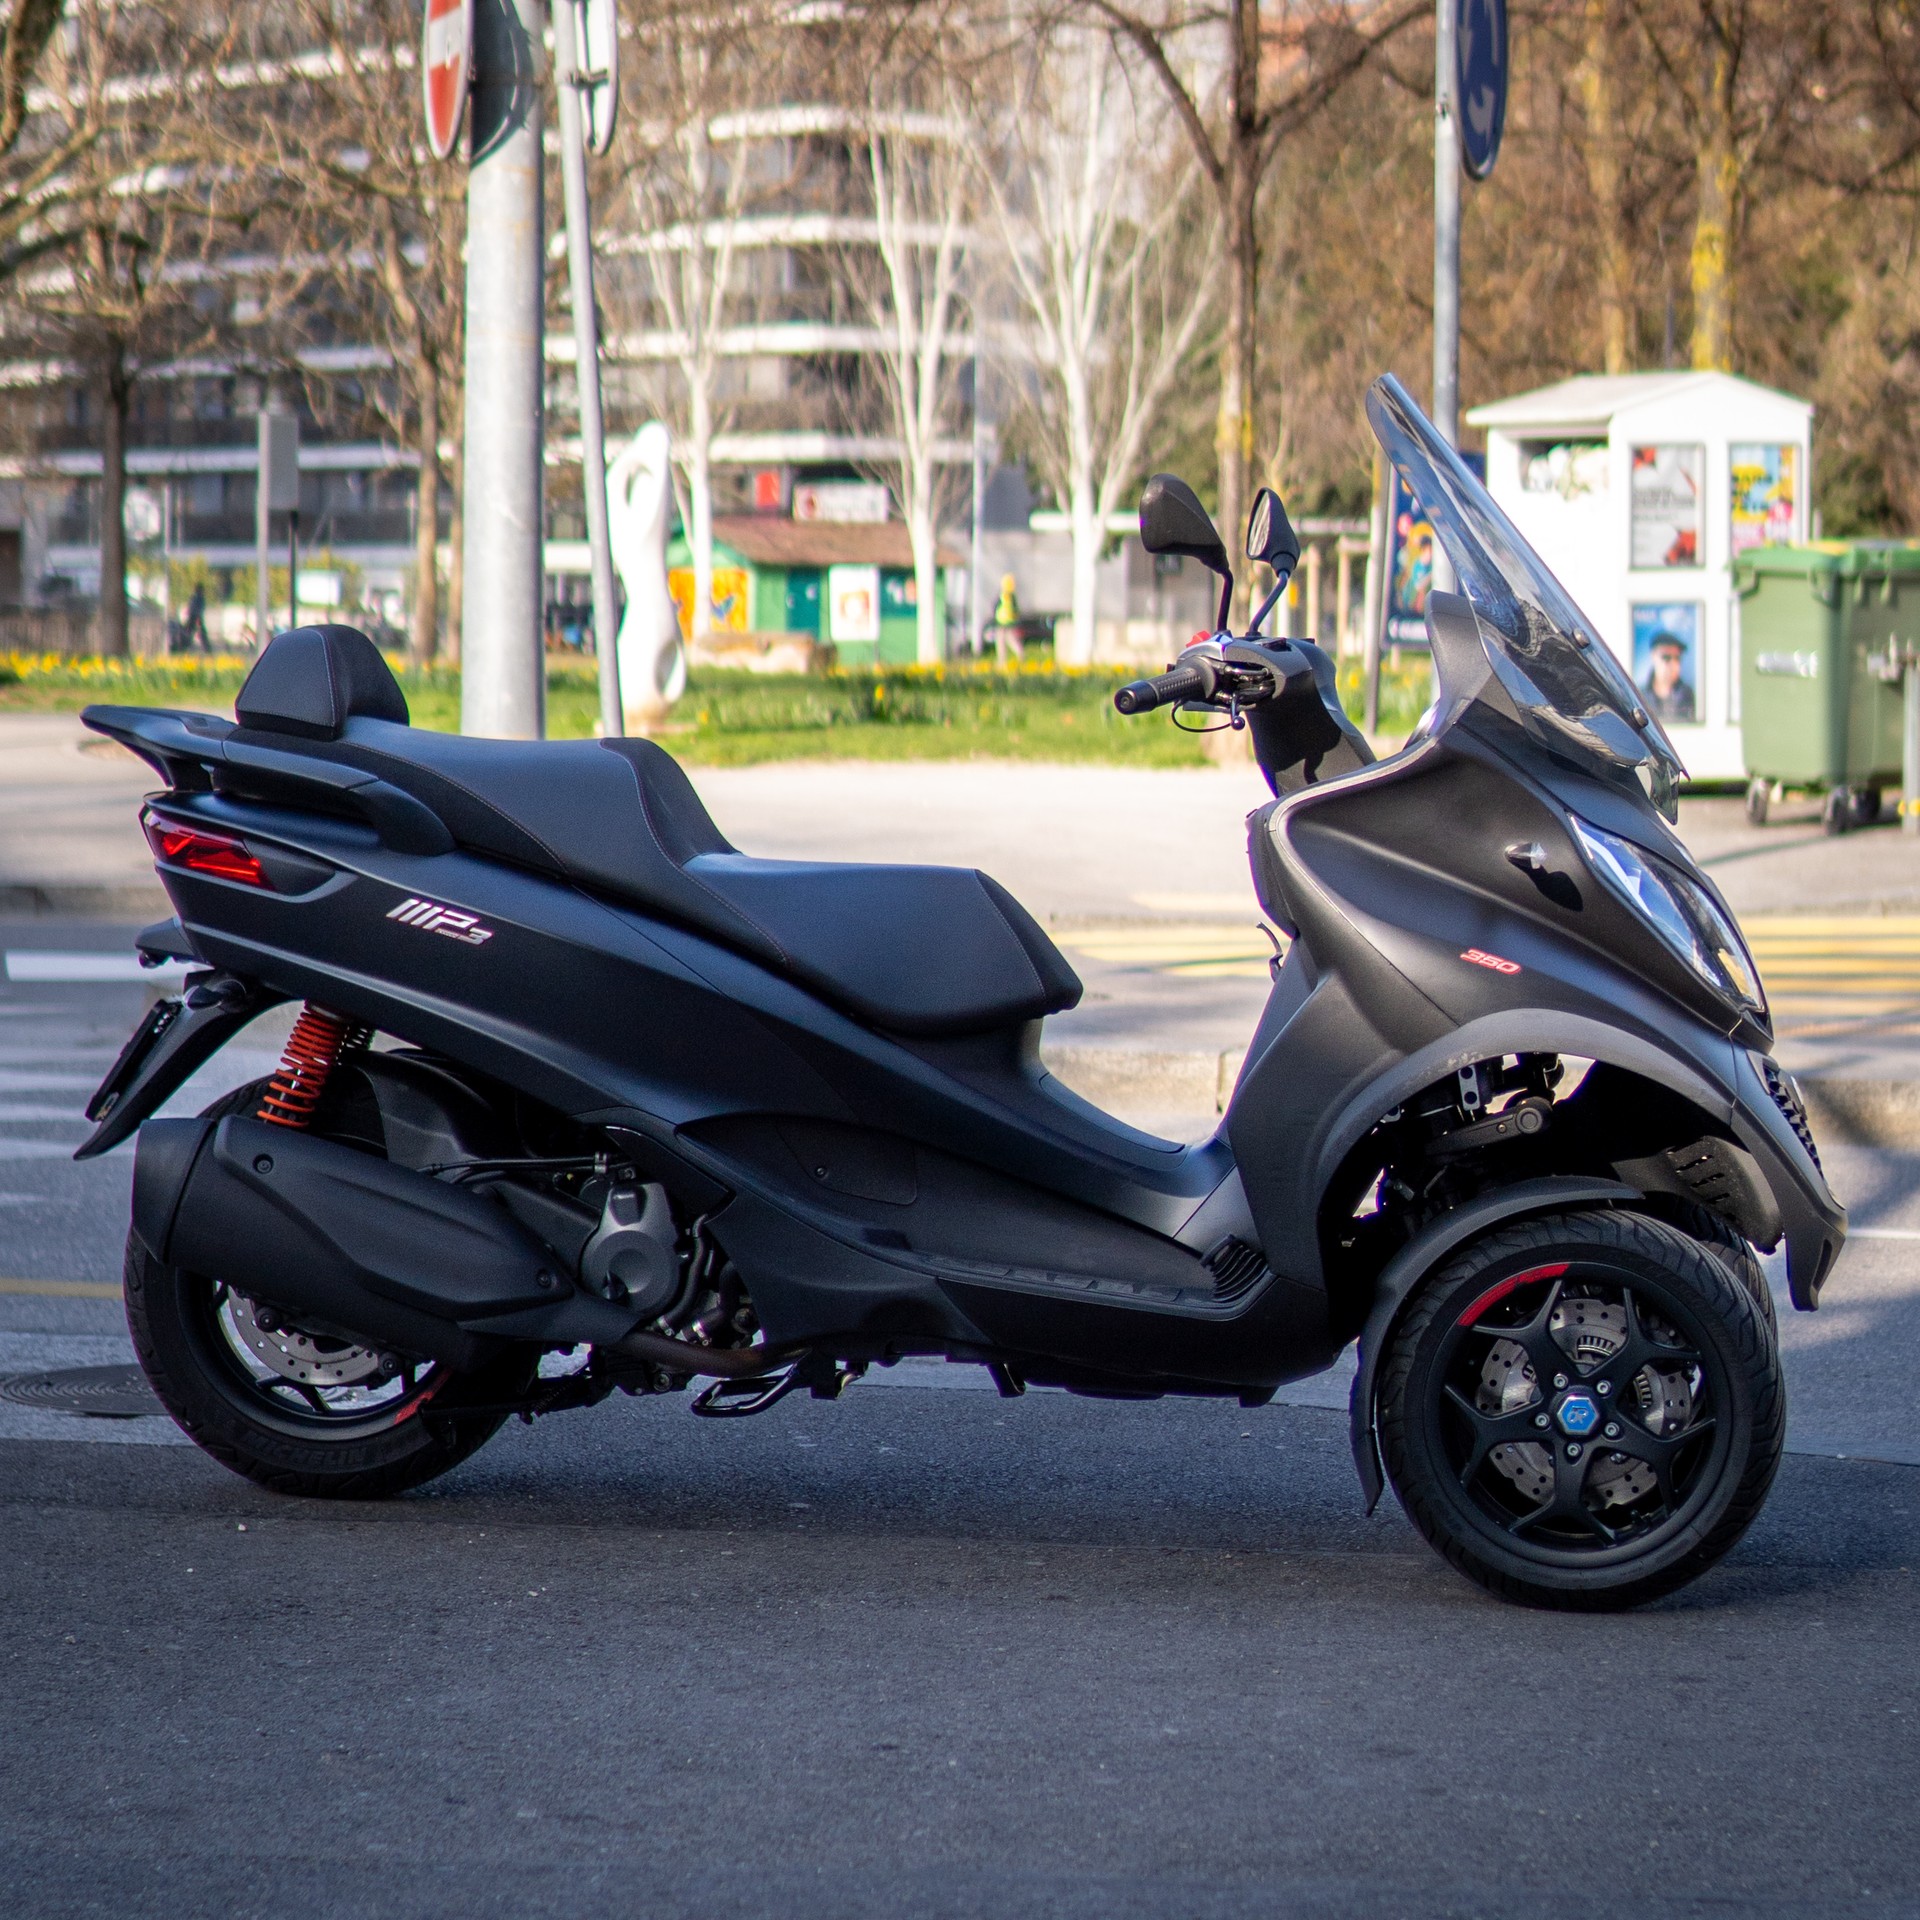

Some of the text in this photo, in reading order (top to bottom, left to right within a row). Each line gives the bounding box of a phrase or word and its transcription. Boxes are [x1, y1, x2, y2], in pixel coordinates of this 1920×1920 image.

[385, 898, 494, 945] MP3
[1460, 948, 1521, 975] 350
[244, 1431, 368, 1467] MICHELIN
